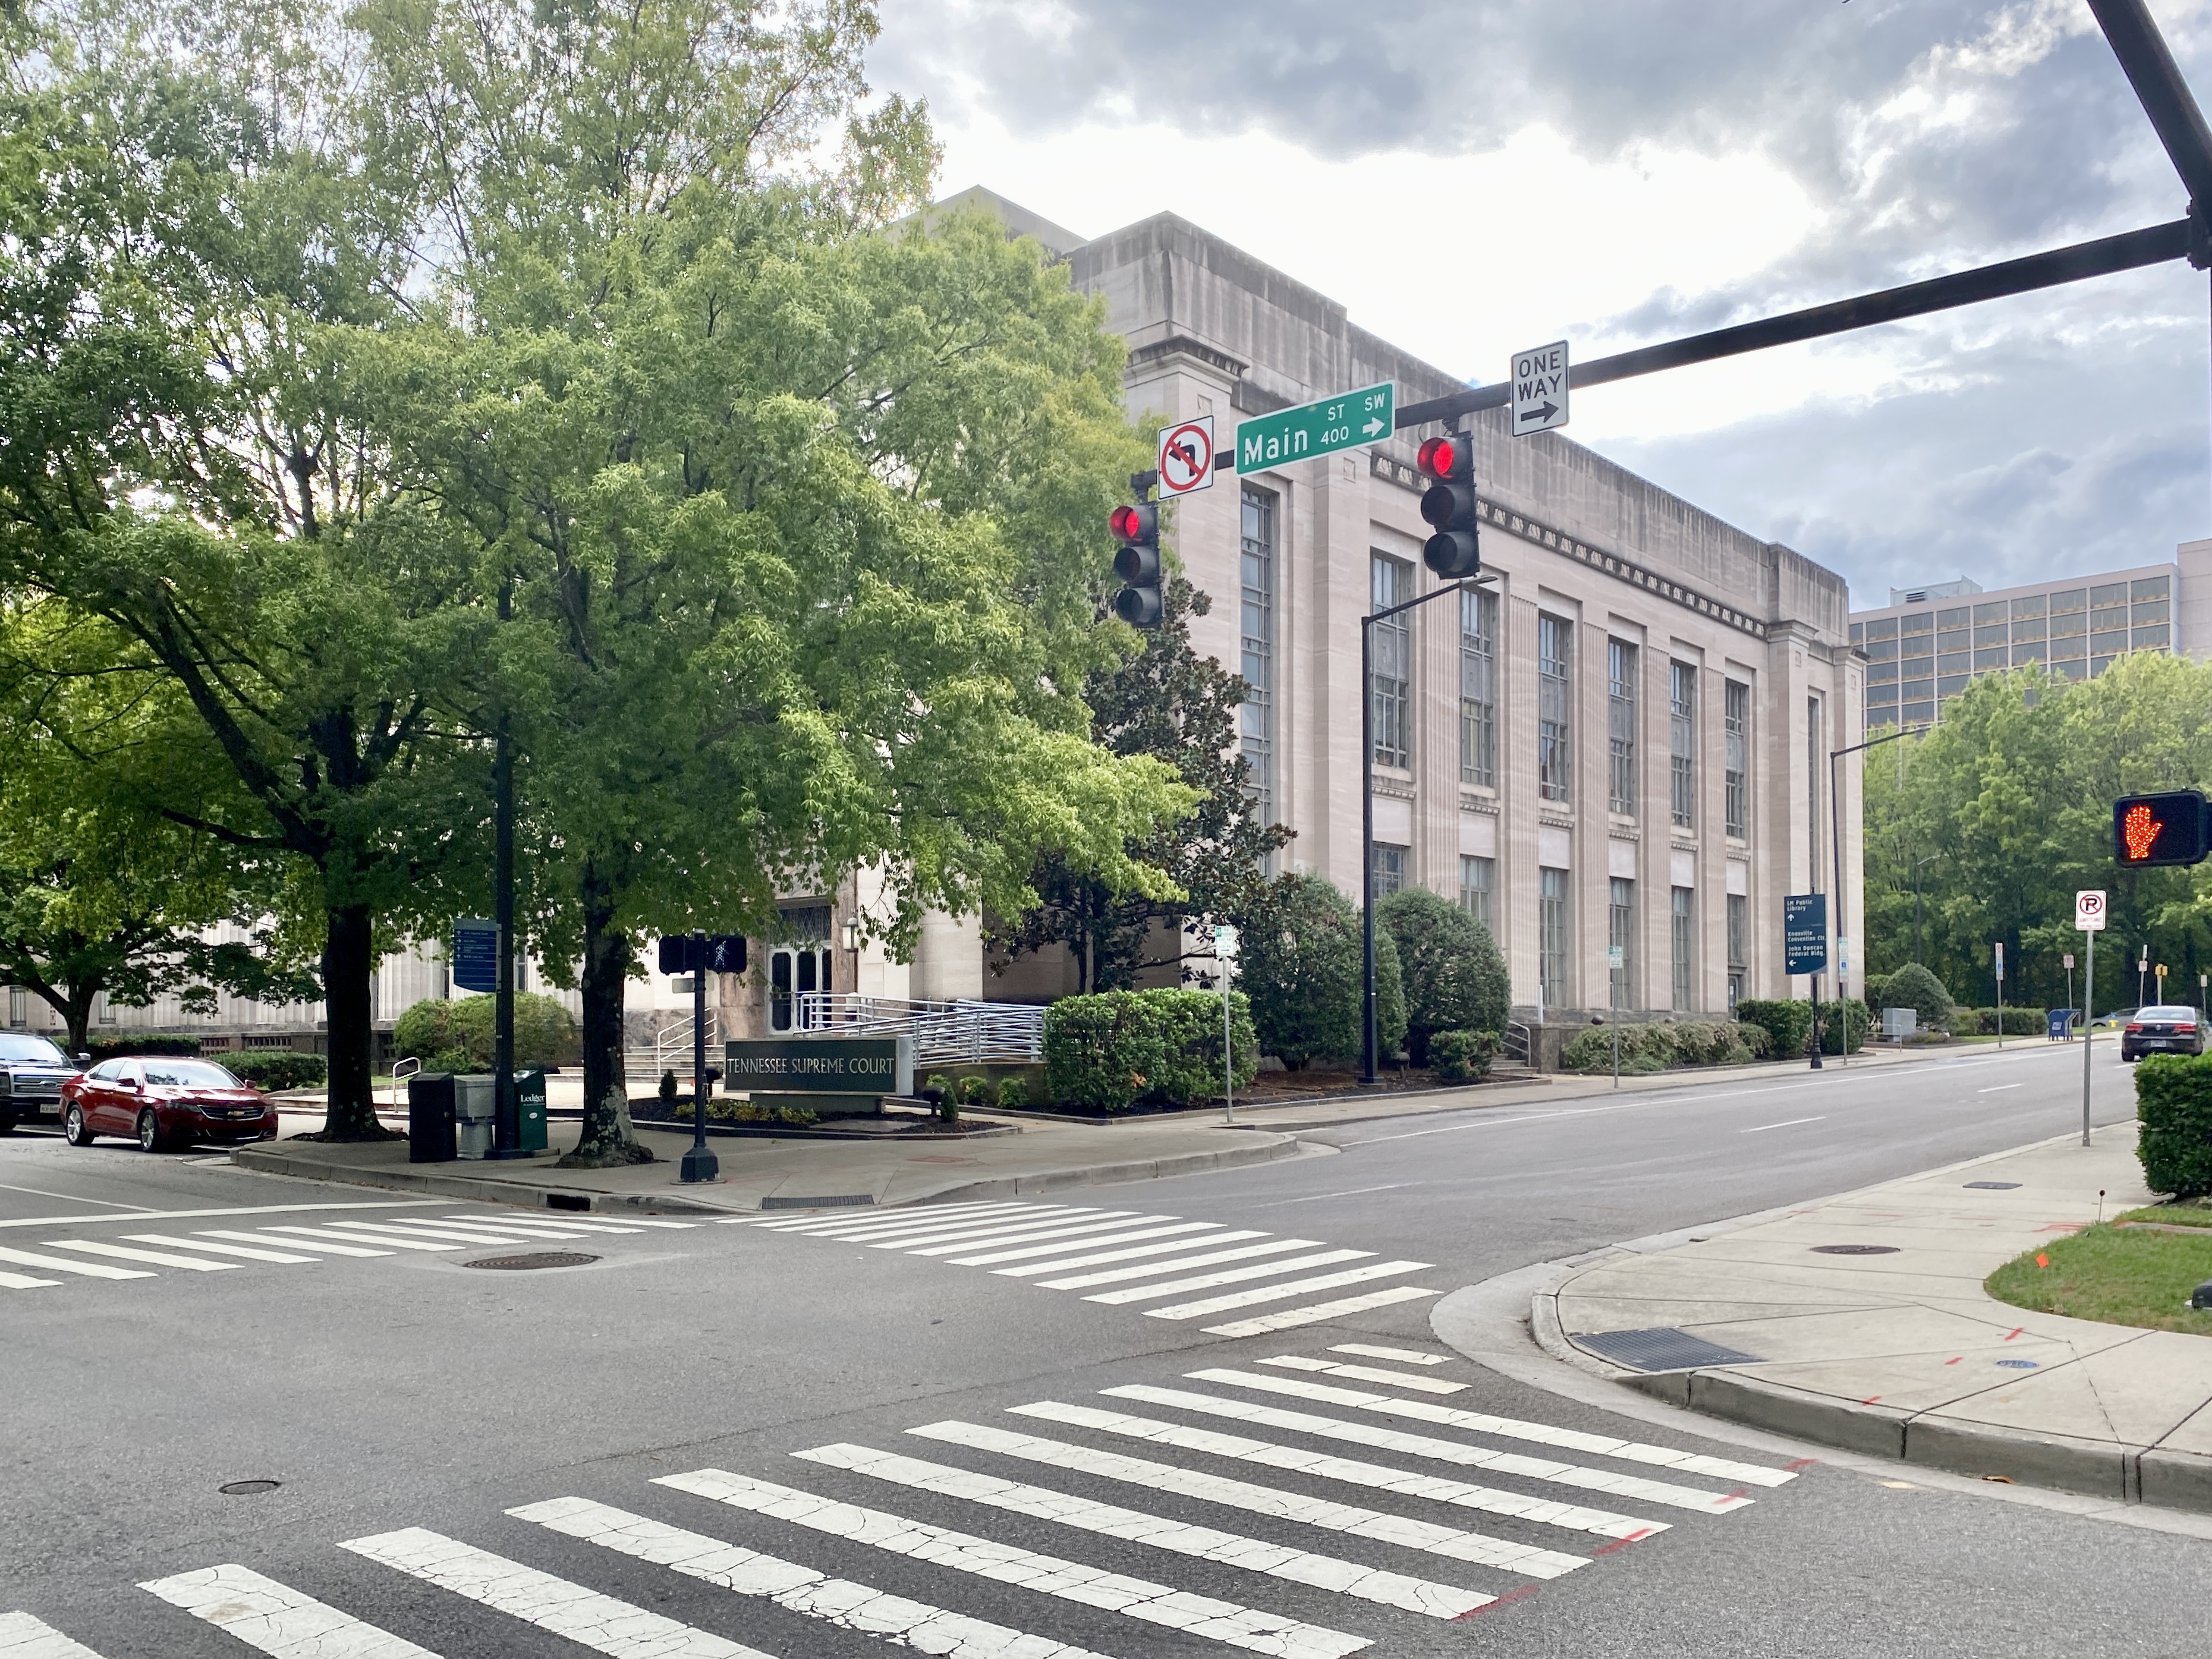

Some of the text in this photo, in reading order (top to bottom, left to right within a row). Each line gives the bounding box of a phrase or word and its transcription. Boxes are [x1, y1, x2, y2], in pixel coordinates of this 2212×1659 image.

[1519, 350, 1561, 378] ONE
[1518, 373, 1562, 402] WAY
[1327, 393, 1385, 421] ST SW
[1244, 426, 1349, 465] Main 400
[727, 1058, 894, 1074] TENNESSEE SUPREME COURT
[520, 1093, 545, 1103] Ledger
